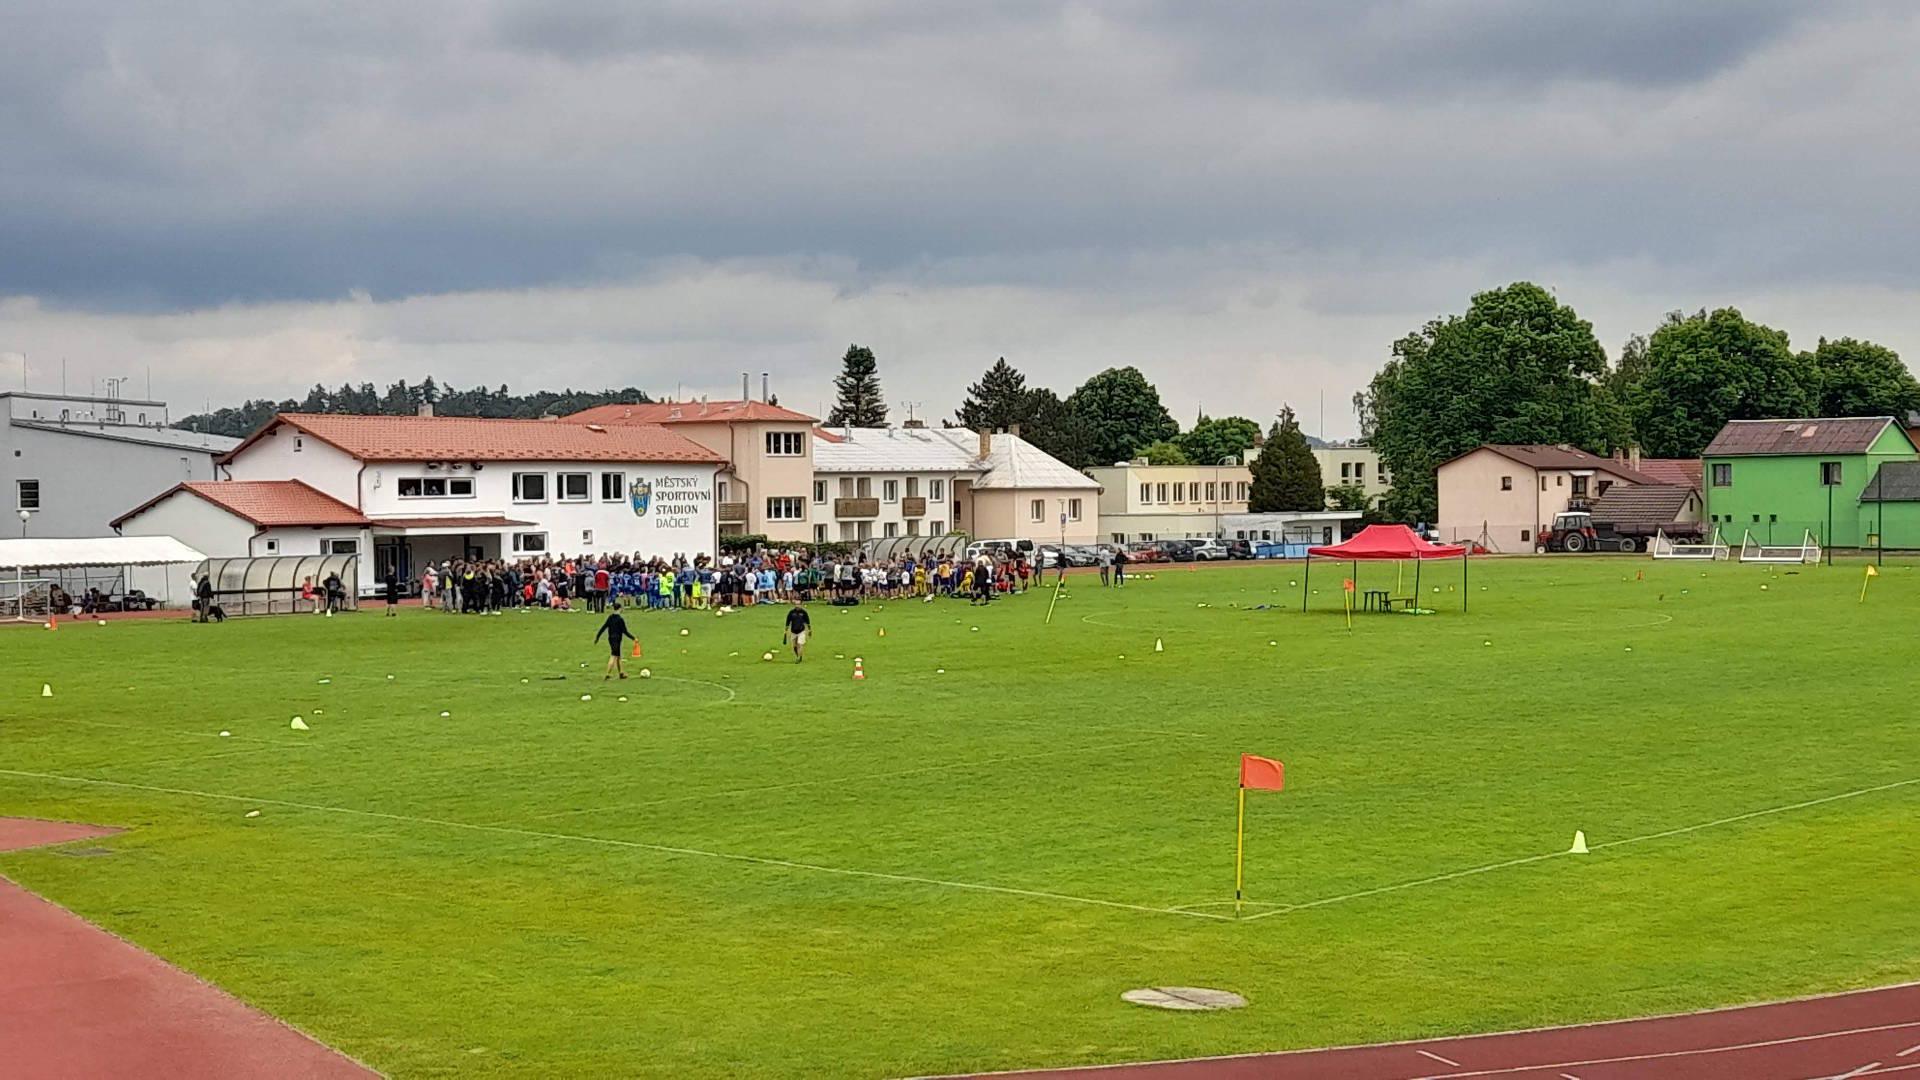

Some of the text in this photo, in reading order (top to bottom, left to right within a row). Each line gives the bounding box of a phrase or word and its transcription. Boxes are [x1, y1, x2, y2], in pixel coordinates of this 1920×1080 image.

[656, 475, 698, 488] MĚSTSKÝ
[655, 488, 711, 501] SPORTOVNÍ
[655, 504, 698, 515] STADION
[656, 516, 689, 528] DAČICE
